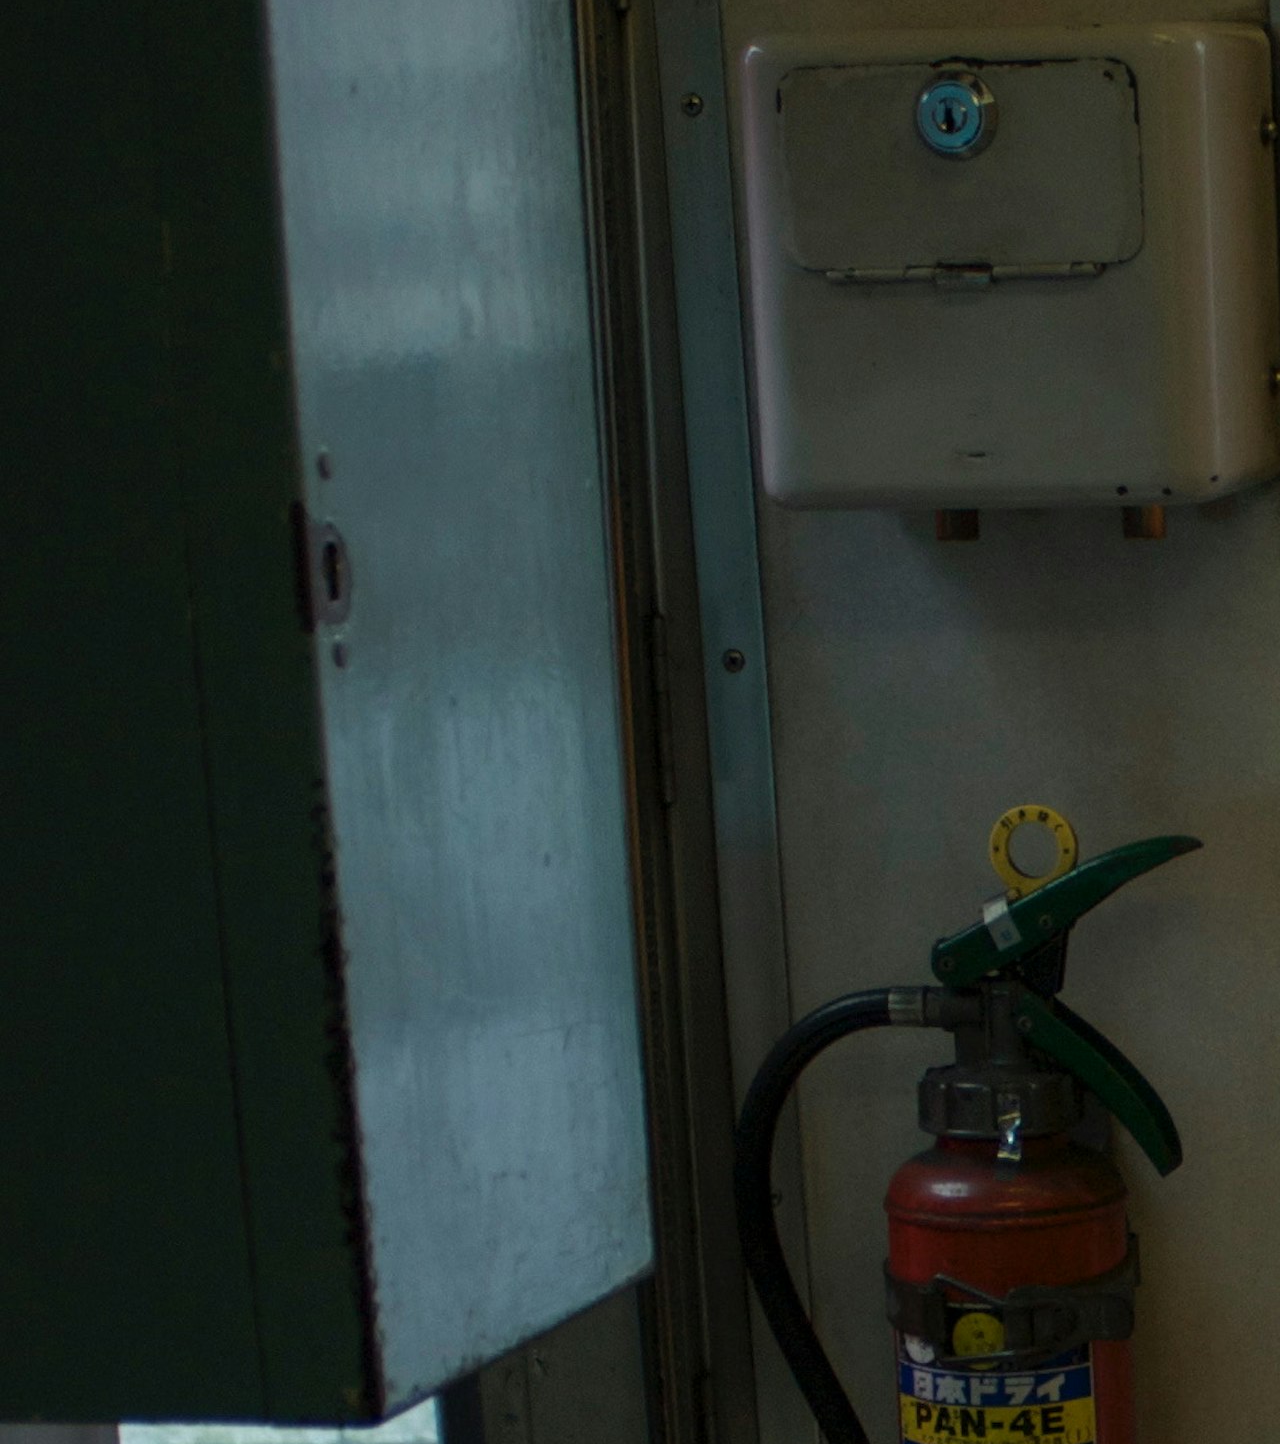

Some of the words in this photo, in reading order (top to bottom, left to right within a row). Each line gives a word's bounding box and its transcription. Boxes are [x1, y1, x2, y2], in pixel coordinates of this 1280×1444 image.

[912, 1368, 1066, 1406] 日本ドライ
[915, 1402, 1066, 1438] PAN-4E
